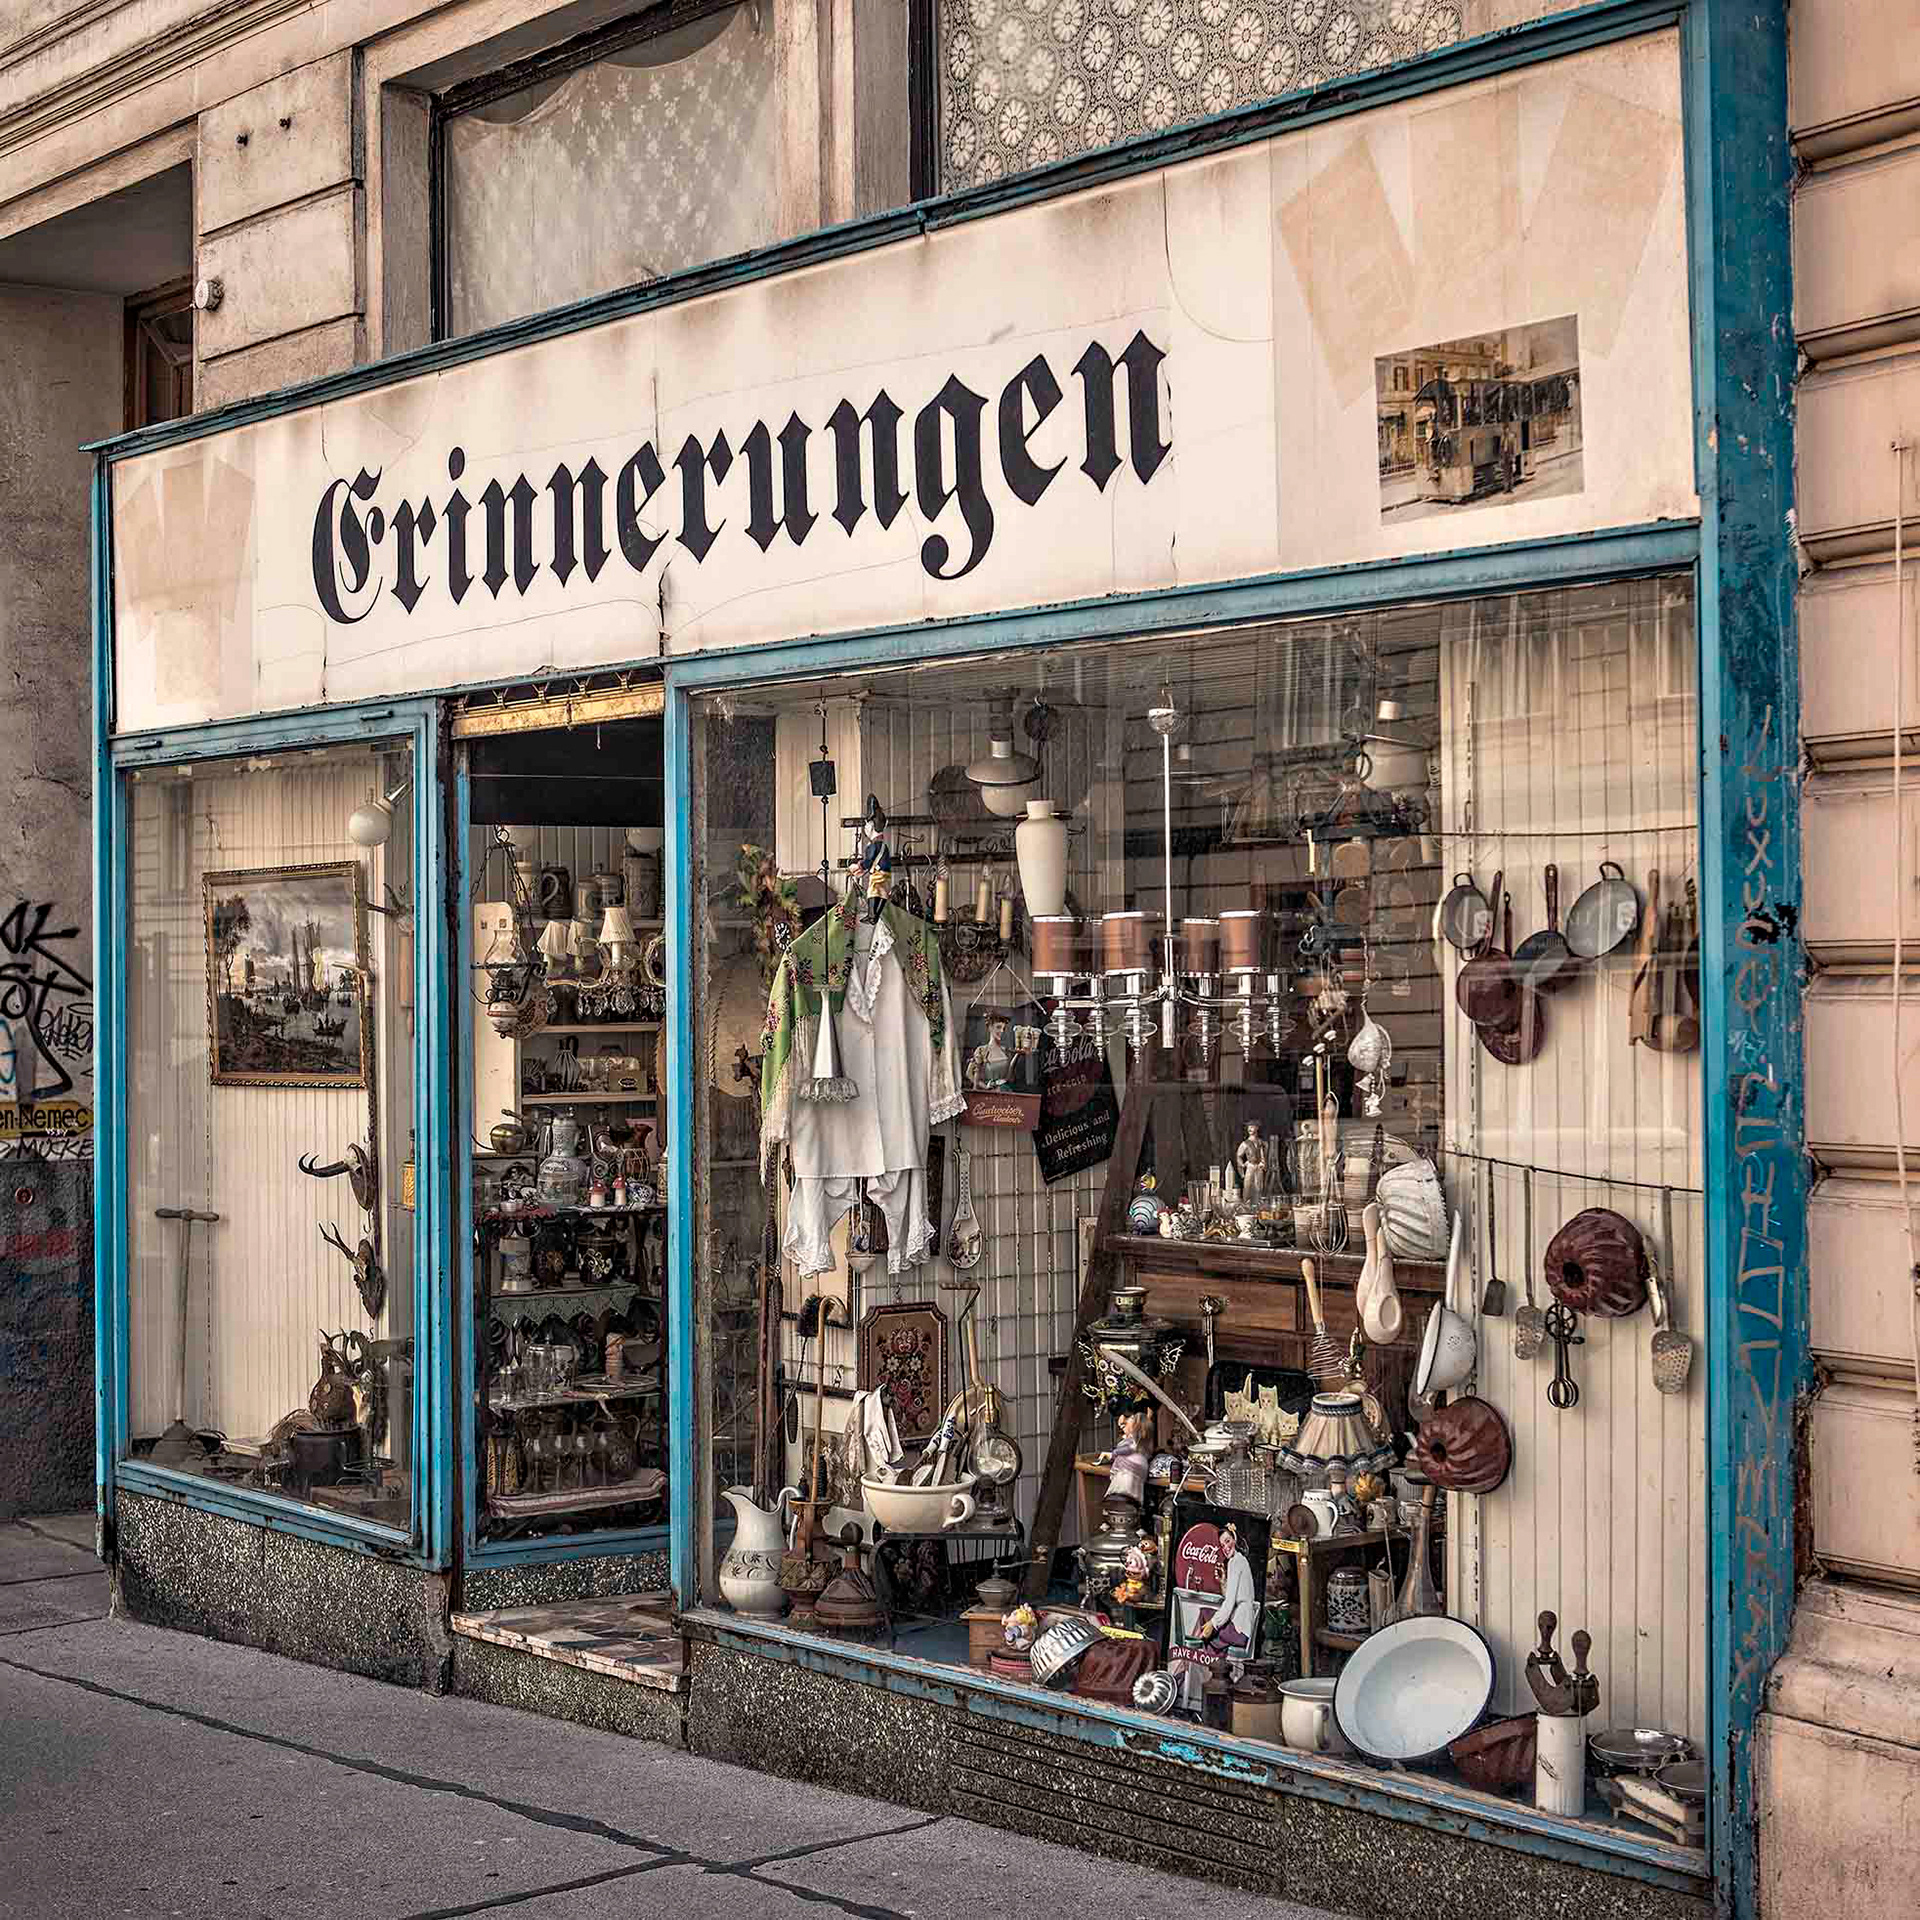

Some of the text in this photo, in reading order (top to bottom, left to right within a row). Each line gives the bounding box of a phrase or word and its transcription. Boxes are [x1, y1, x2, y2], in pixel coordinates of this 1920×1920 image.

[312, 330, 1172, 623] Erinnerungen
[1044, 1109, 1111, 1146] Delicious and
[1056, 1133, 1109, 1160] Refreshing
[1172, 1648, 1190, 1659] HAVE
[1193, 1651, 1198, 1661] A
